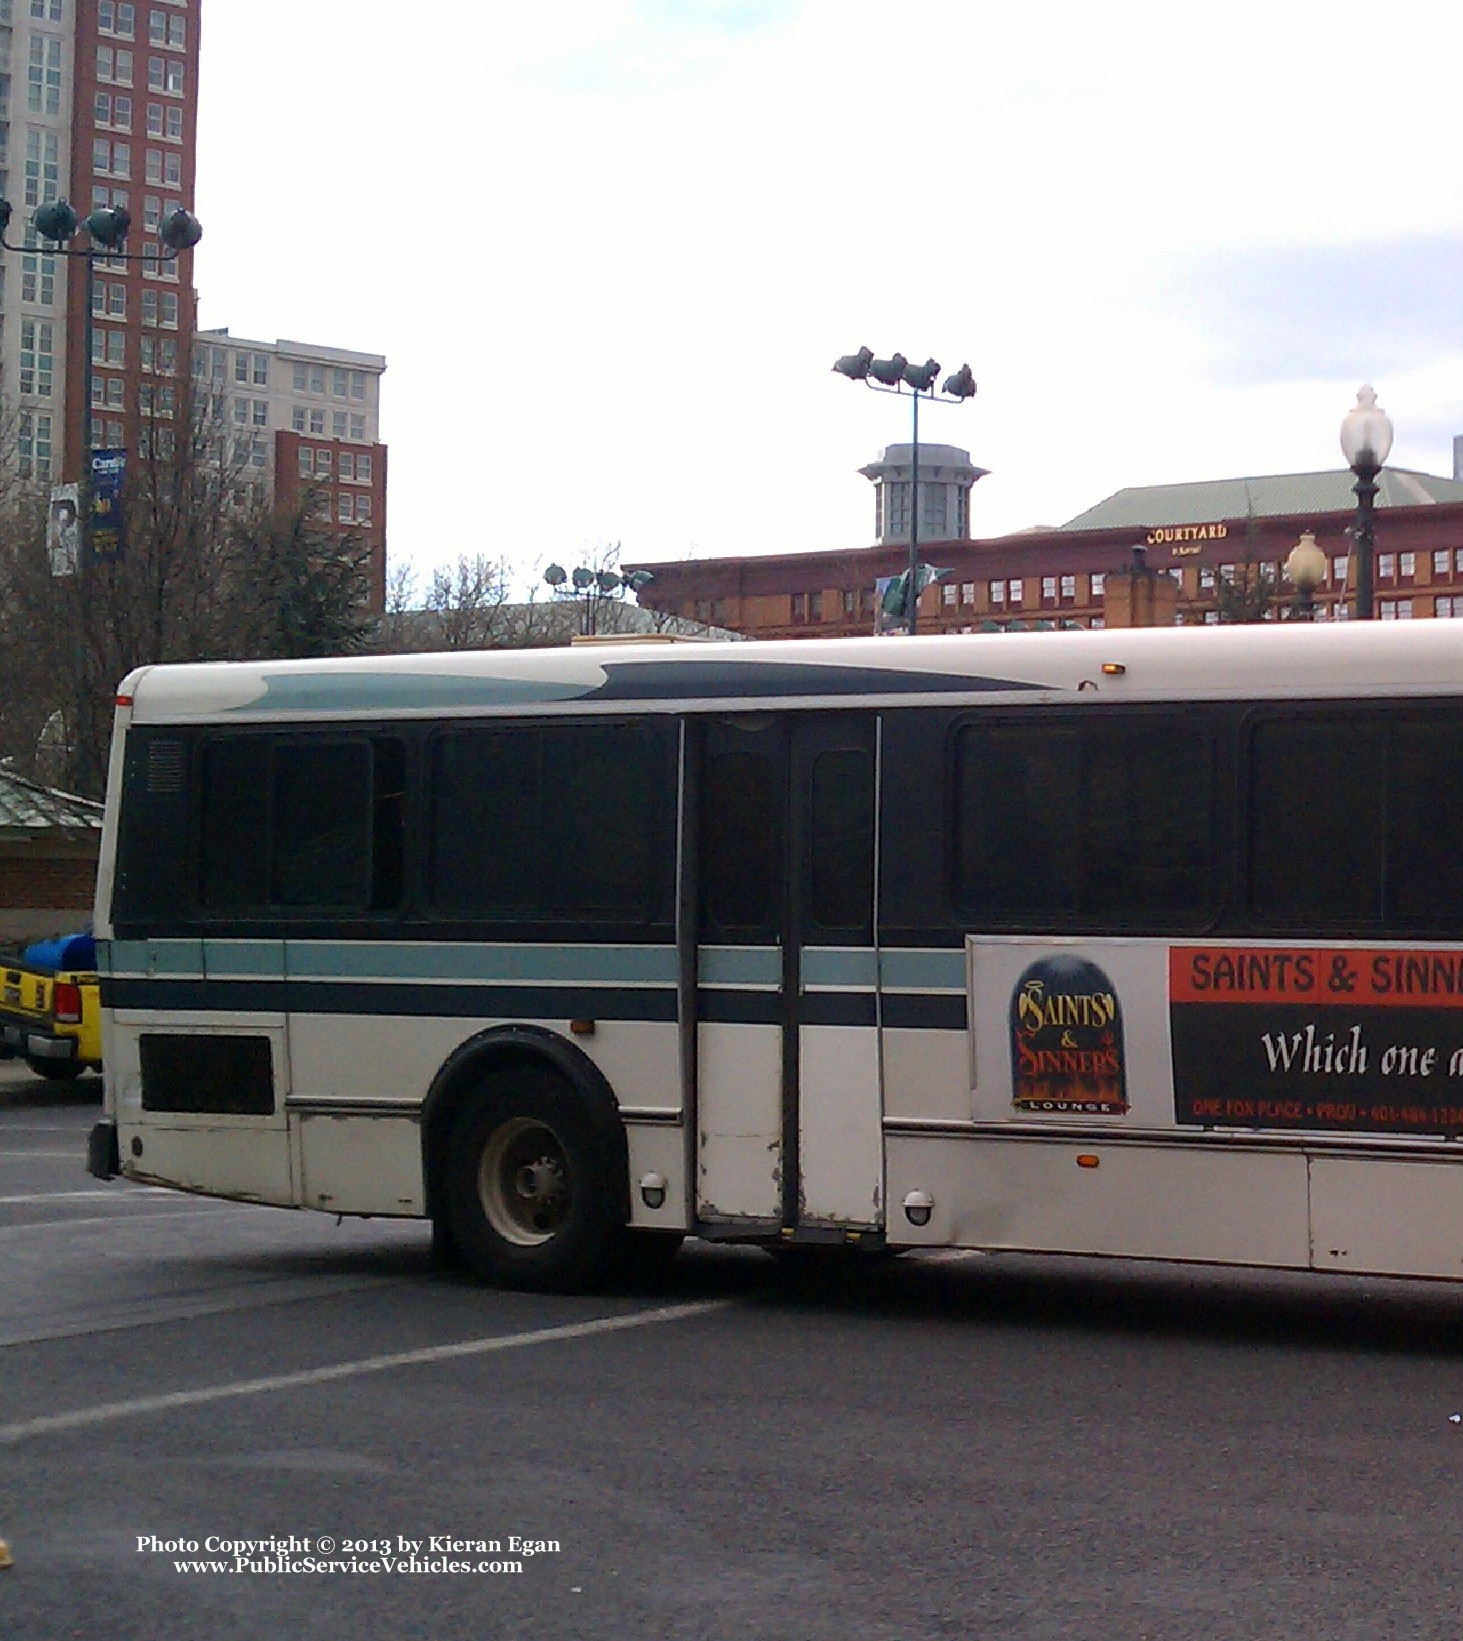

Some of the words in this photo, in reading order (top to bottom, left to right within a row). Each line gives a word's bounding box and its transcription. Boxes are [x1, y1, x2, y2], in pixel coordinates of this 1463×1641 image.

[1147, 524, 1228, 544] COURTYARD
[1192, 953, 1315, 992] SAINTS
[1328, 955, 1358, 992] &
[1061, 1029, 1078, 1048] &
[1261, 1024, 1369, 1073] Which
[1382, 1045, 1439, 1076] one
[1029, 1101, 1111, 1112] LOUNGE
